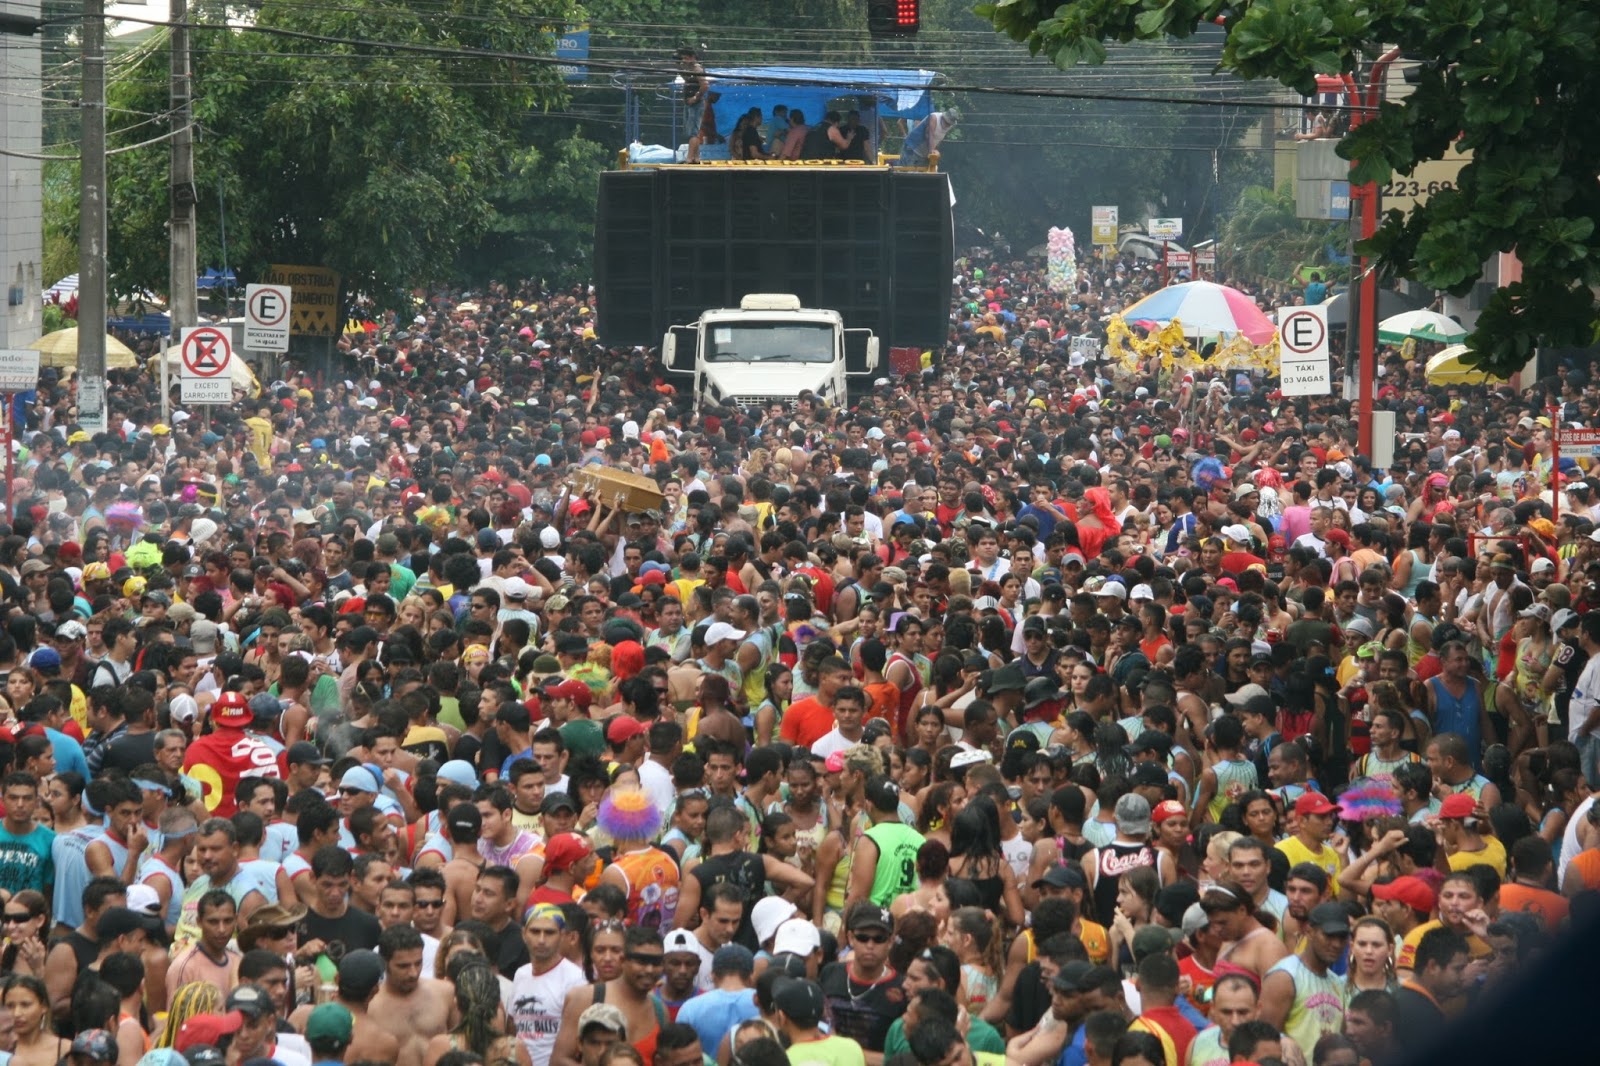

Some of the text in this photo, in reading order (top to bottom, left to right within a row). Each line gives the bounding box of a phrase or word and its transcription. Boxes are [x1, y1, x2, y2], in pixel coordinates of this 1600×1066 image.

[287, 272, 335, 288] OBSTRUA
[291, 291, 334, 306] ZAMENTO
[260, 295, 276, 319] E
[1293, 317, 1313, 347] E
[1073, 338, 1098, 348] SKOL
[0, 354, 21, 362] ndo
[1295, 364, 1315, 372] TÁXI
[1283, 375, 1325, 384] 03 VAGAS
[1572, 432, 1580, 442] DE
[900, 858, 915, 887] 9
